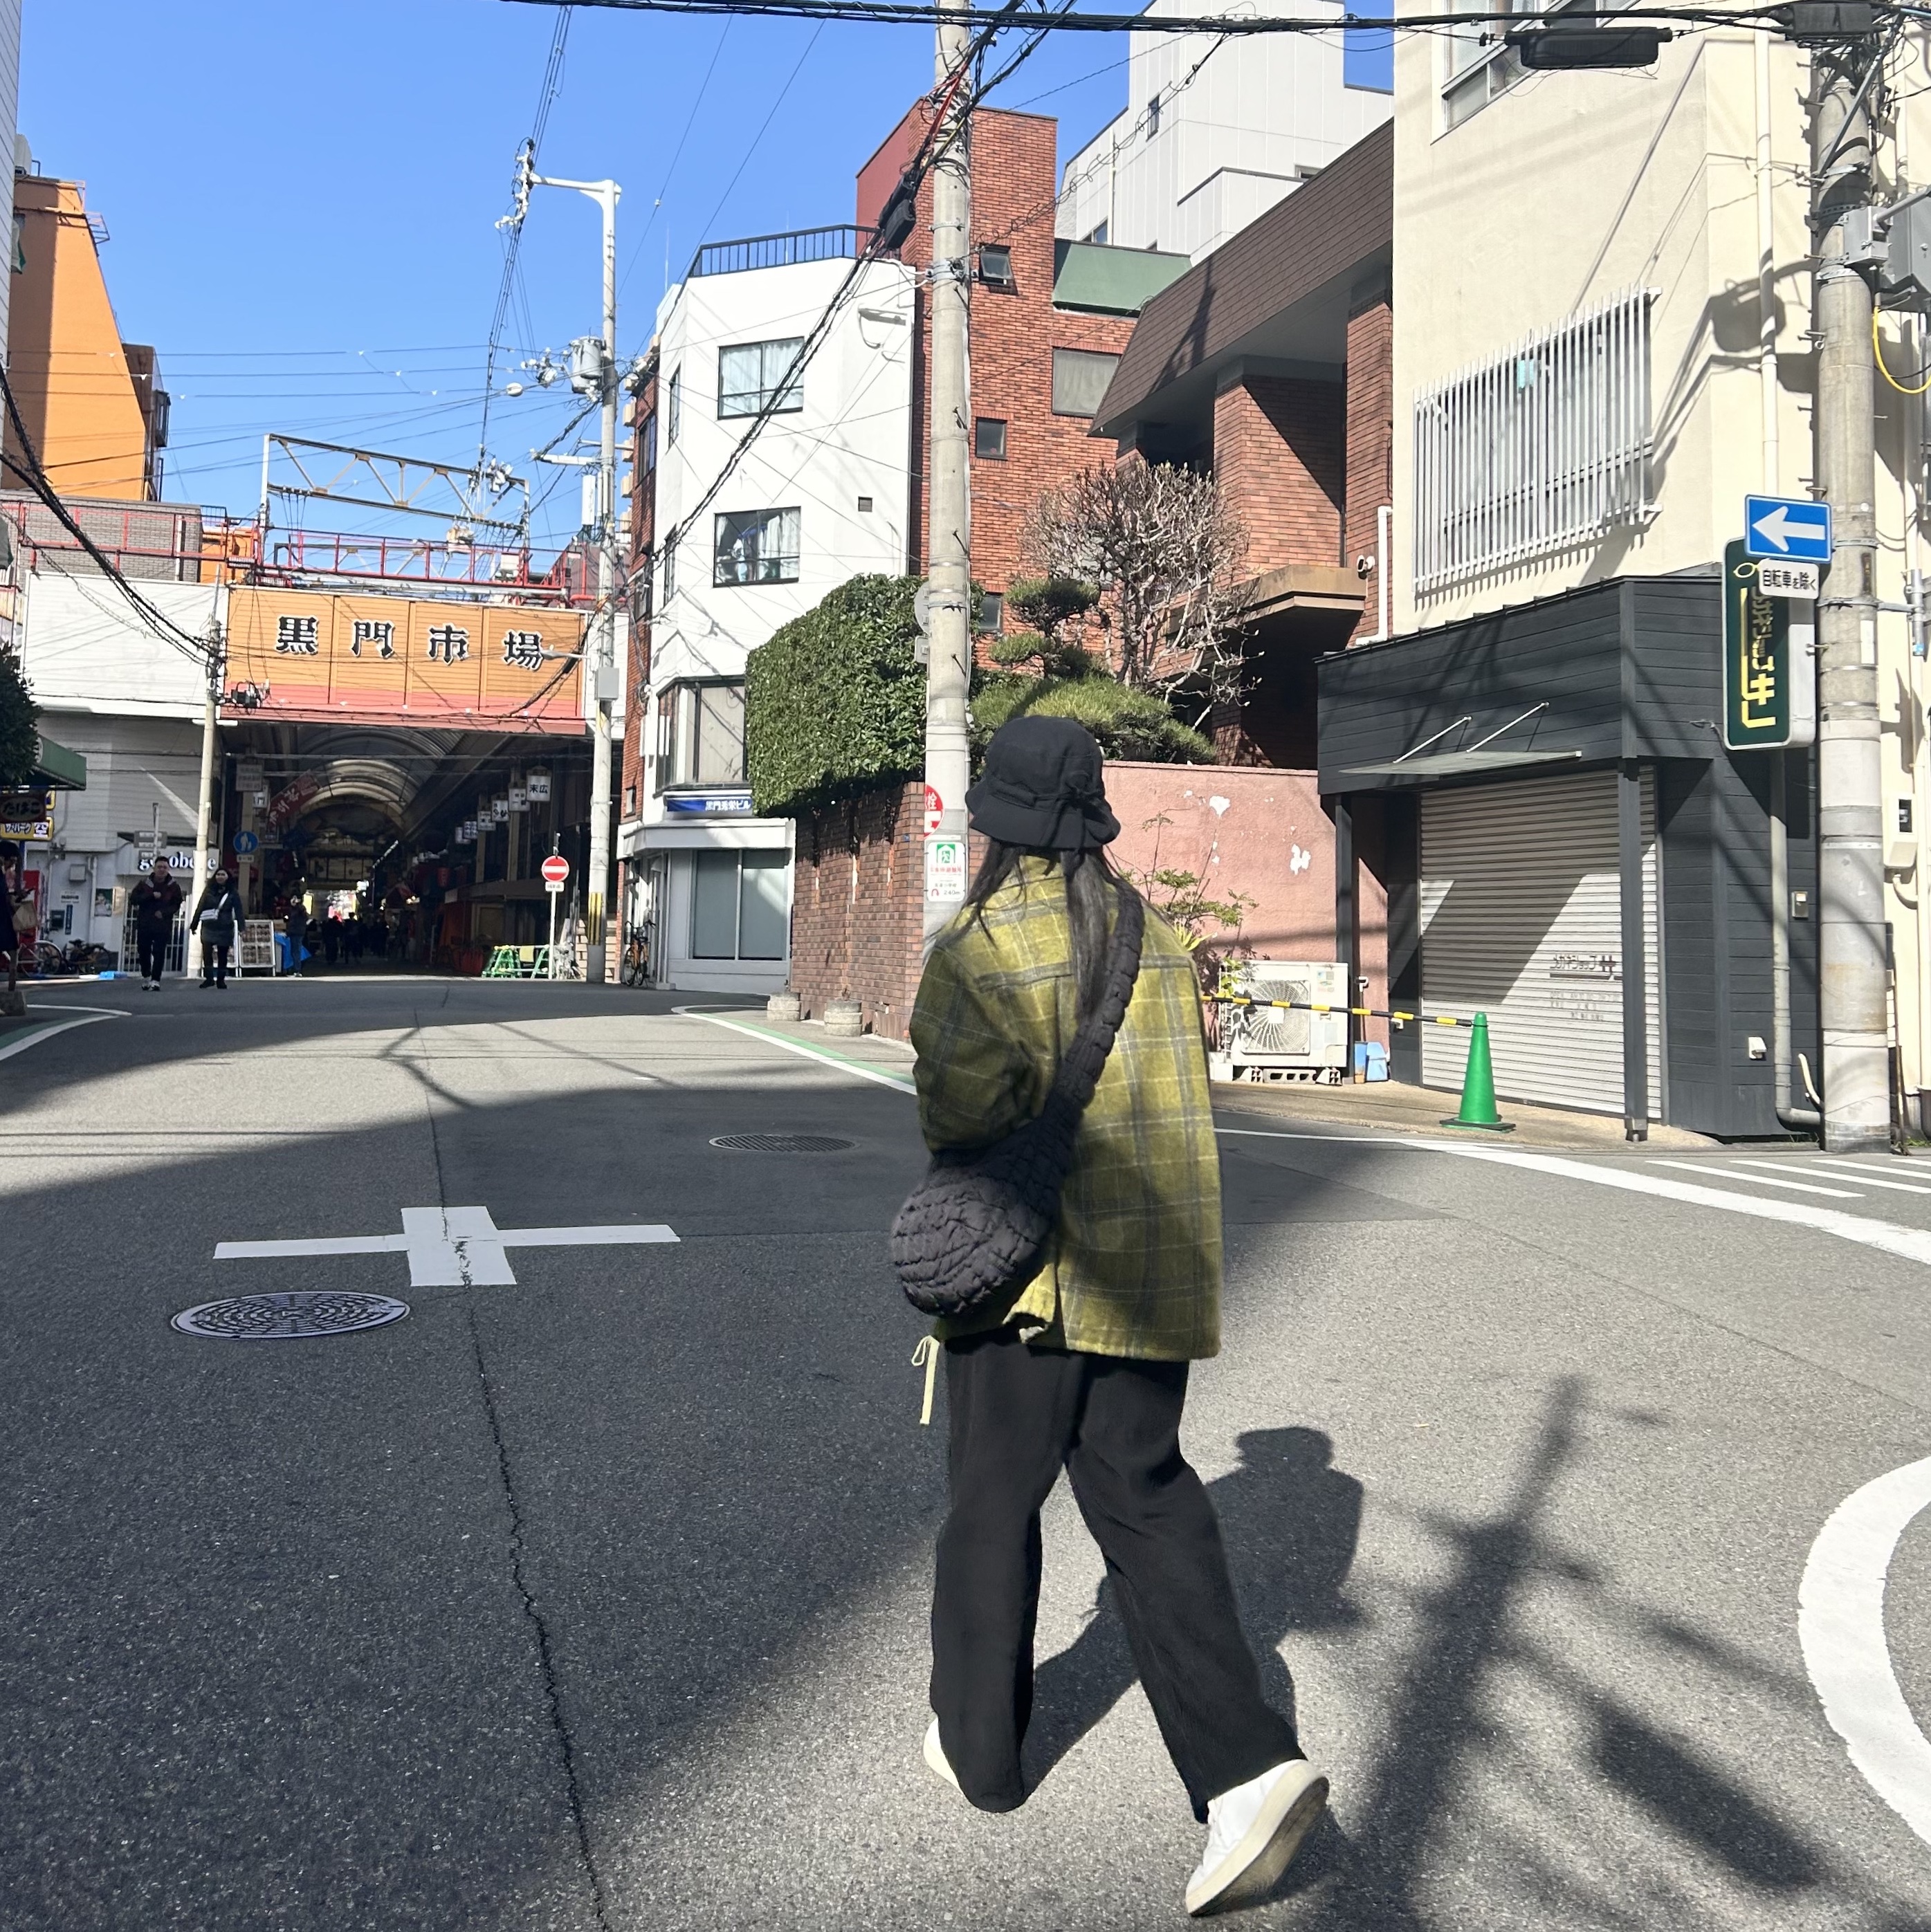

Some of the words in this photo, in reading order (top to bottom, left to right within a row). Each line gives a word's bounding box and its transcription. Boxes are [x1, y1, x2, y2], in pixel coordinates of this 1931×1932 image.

[1763, 569, 1816, 591] 自転車を除く
[275, 614, 545, 671] 黒門市場
[2, 801, 42, 816] たばこ
